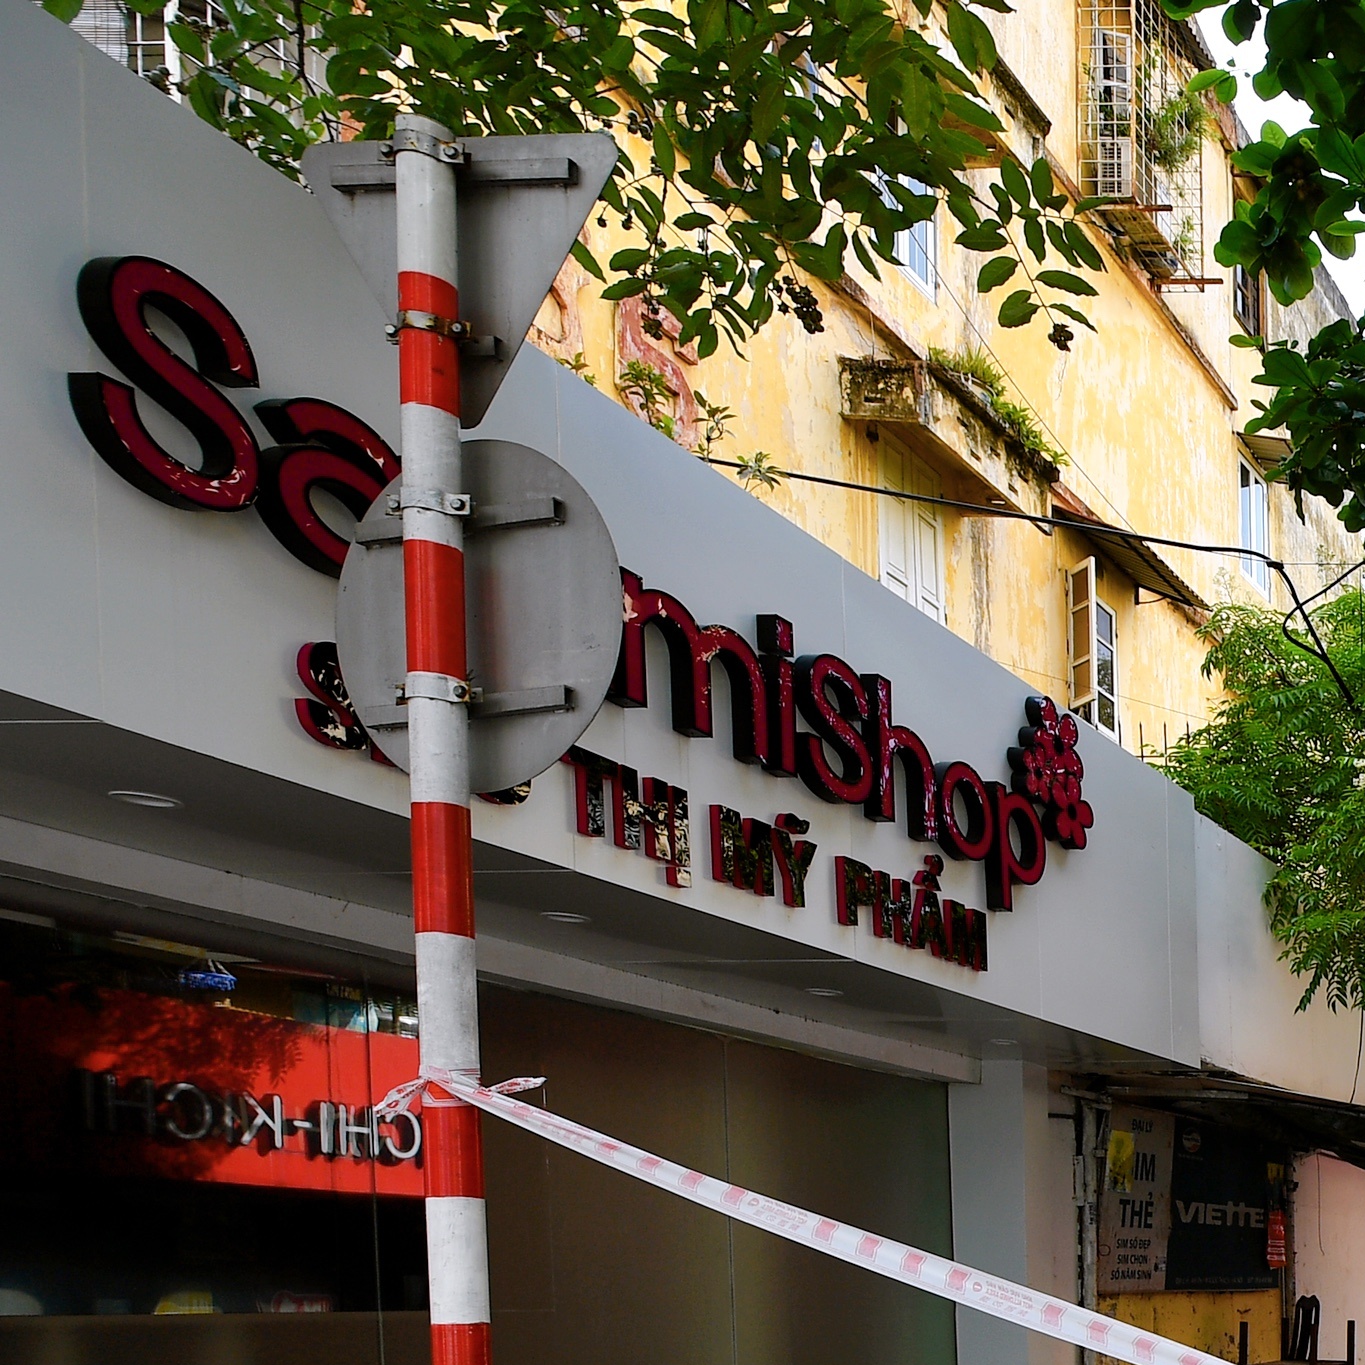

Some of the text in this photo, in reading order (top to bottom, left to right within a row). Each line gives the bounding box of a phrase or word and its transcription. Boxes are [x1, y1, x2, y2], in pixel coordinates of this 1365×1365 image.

[709, 803, 818, 908] MỸ
[833, 854, 989, 972] PHẨM
[1119, 1191, 1155, 1230] THẺ
[1116, 1238, 1128, 1249] SIM
[1117, 1254, 1129, 1264] SIM
